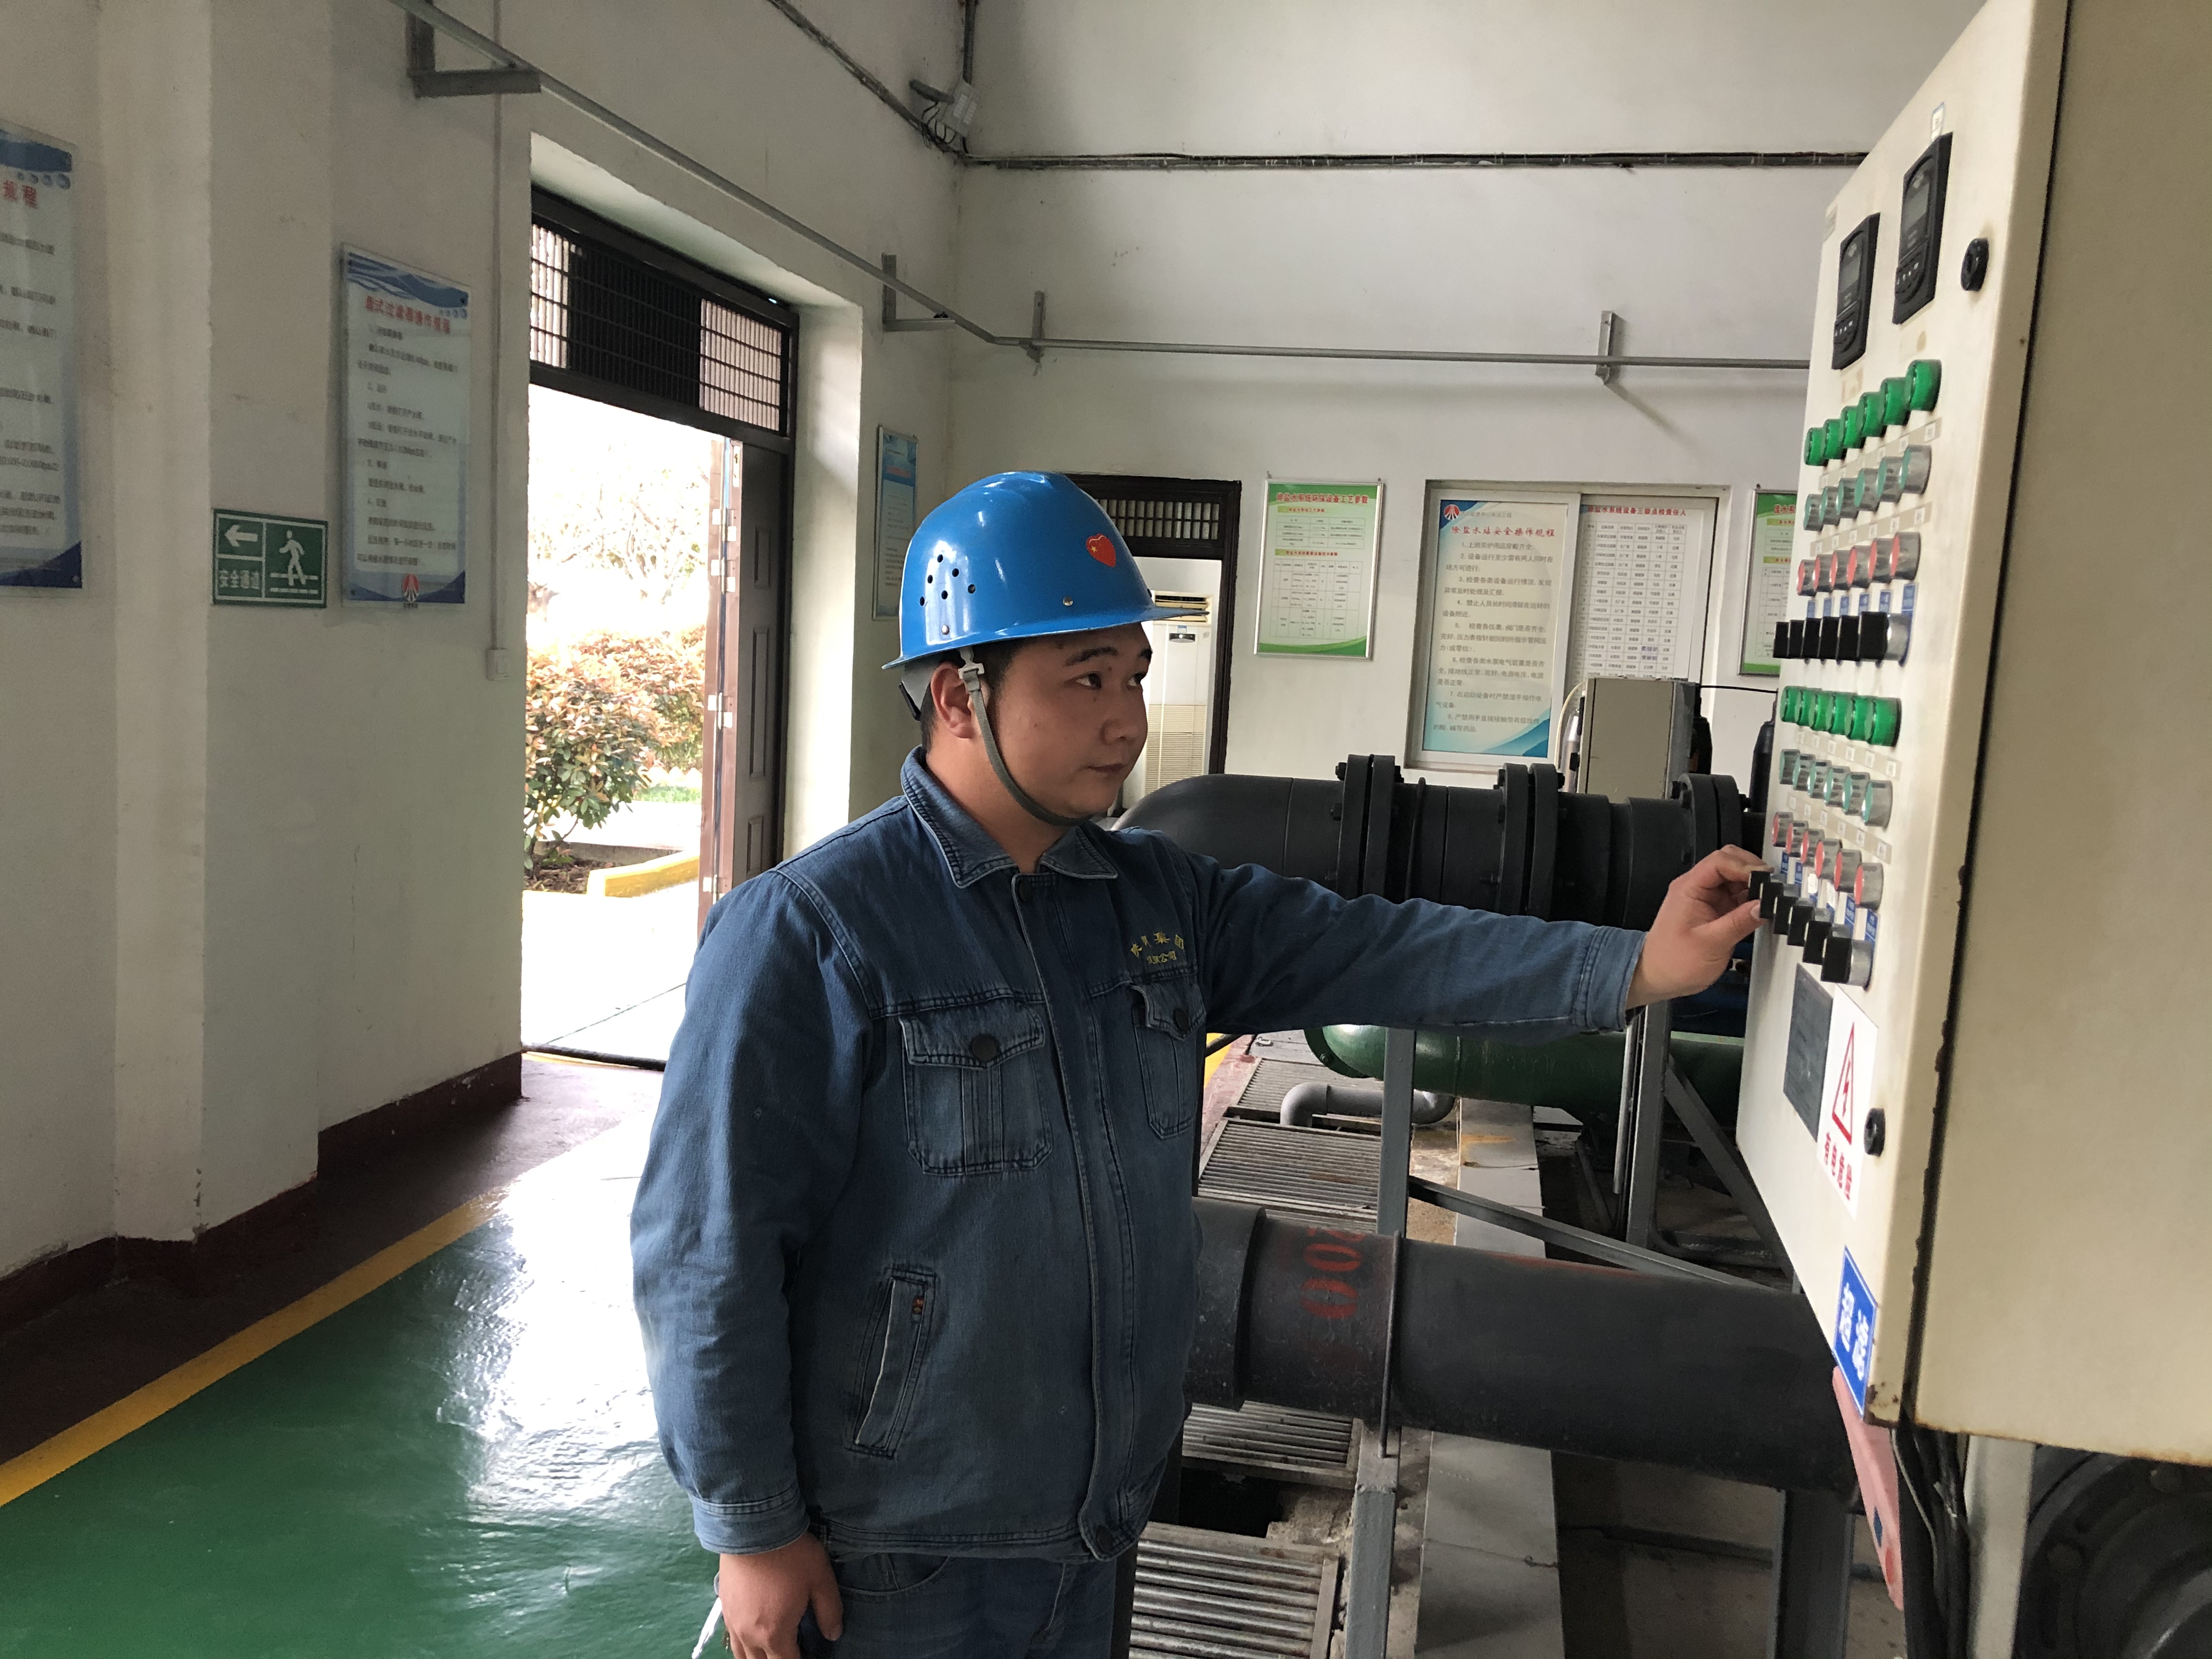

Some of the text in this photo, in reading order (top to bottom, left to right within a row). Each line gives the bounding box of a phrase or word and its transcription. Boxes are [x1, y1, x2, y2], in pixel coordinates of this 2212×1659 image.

[1277, 493, 1369, 504] 除盐水系统环保设备工艺参数
[1451, 525, 1555, 537] 除盐水站安全操作规程
[219, 569, 260, 590] 安全通道
